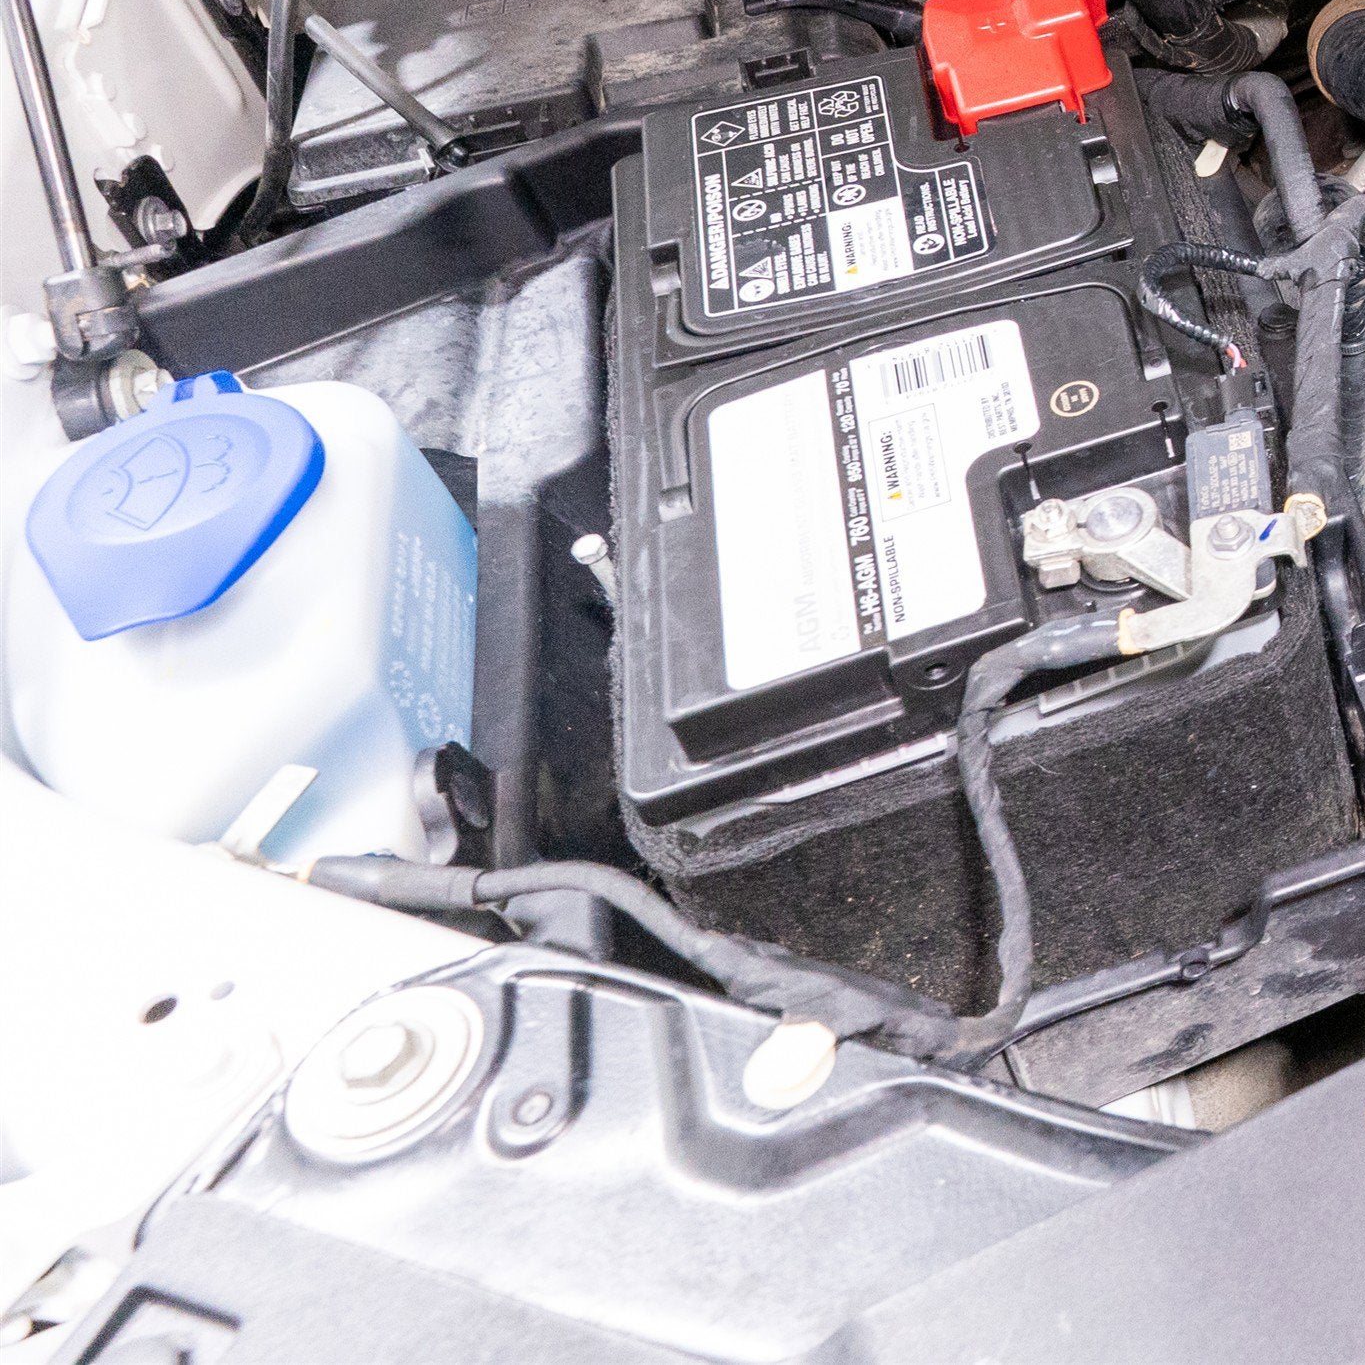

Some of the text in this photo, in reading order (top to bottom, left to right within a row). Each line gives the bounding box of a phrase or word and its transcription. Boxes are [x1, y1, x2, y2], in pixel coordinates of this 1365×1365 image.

[830, 134, 844, 145] DO
[845, 129, 860, 145] NOT
[857, 117, 875, 143] OPEN.
[914, 215, 926, 234] READ
[920, 182, 937, 232] INSTRUCTIONS.
[943, 178, 966, 248] NON-SPILLABLE
[959, 180, 977, 238] Lead Acid Battery
[705, 174, 728, 279] DANGER/POISON
[842, 222, 856, 266] WARNING:
[833, 378, 850, 395] 70
[838, 414, 855, 432] 120
[982, 404, 995, 439] DISTRIBUTED
[844, 459, 862, 482] 950
[880, 431, 899, 490] WARNING:
[848, 515, 870, 546] 760
[854, 554, 880, 616] H6-AGM
[884, 536, 905, 623] NON-SPILLABLE
